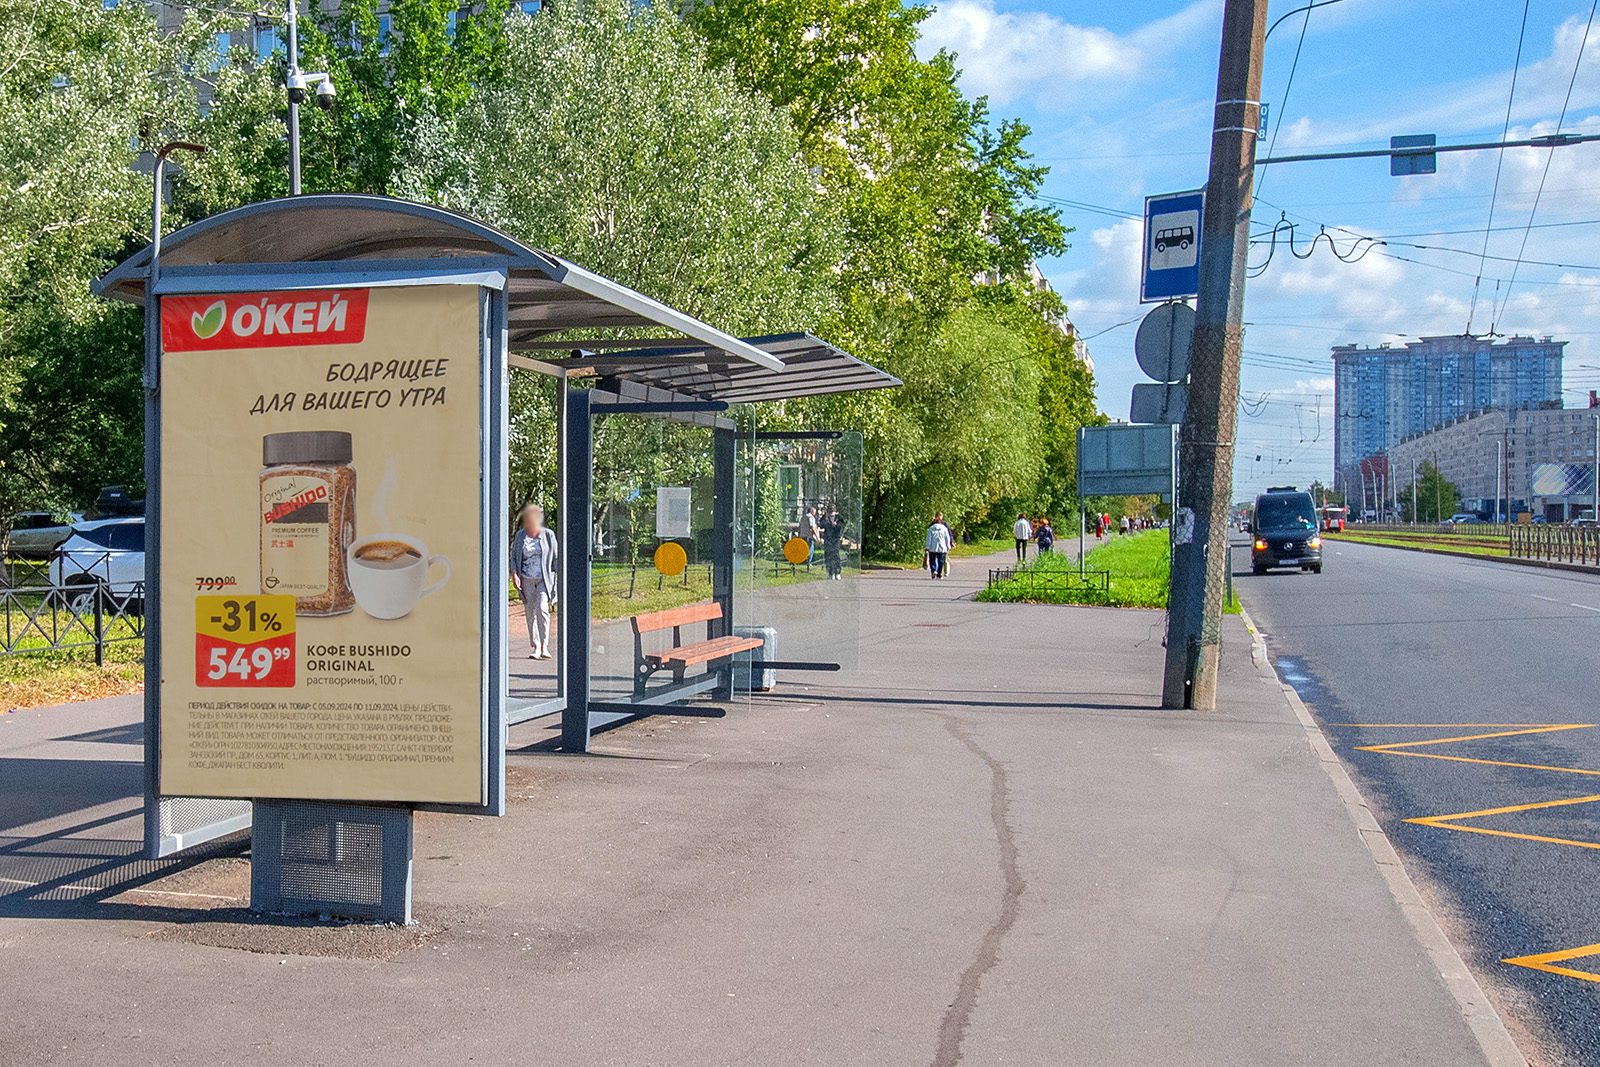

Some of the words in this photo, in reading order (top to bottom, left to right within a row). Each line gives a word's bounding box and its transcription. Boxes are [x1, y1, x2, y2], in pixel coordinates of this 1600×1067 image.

[326, 358, 449, 382] БОДРЯЩЕЕ
[249, 392, 295, 415] ДЛЯ
[302, 389, 391, 411] ВАШЕГО
[399, 386, 446, 409] УТРА
[264, 477, 297, 502] Original
[264, 485, 327, 524] BUSHIDO
[307, 644, 346, 657] КОФЕ
[350, 645, 411, 657] BUSHIDO
[307, 660, 374, 672] ORIGINAL
[307, 675, 378, 687] растворимый,
[379, 675, 396, 686] 100
[399, 677, 404, 686] г
[189, 702, 214, 710] ПЕРИОД
[216, 702, 249, 710] ДЕЙСТВИЯ
[250, 702, 277, 710] СКИДОК
[278, 702, 288, 711] НА
[312, 703, 317, 711] С
[354, 703, 363, 711] ПО
